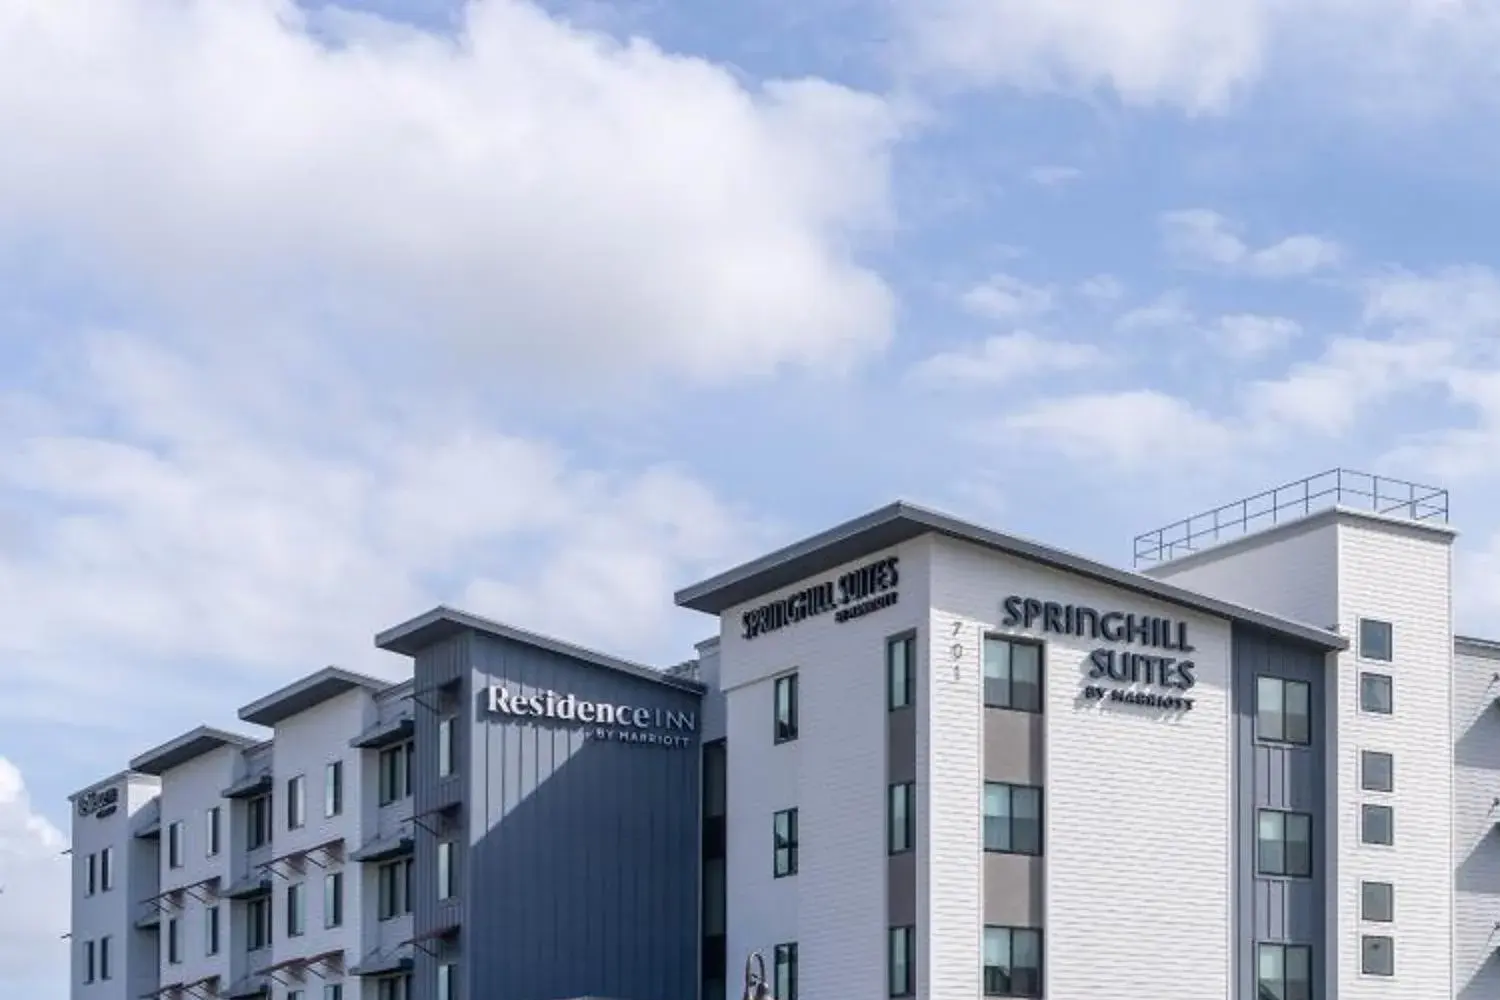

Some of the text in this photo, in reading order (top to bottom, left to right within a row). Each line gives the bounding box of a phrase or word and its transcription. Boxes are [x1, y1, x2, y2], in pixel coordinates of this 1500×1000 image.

[1002, 595, 1195, 651] SPRINGHILL
[950, 622, 963, 681] 701
[1088, 648, 1195, 690] SUITES
[488, 685, 696, 731] Residence INN
[619, 730, 690, 748] MARRIOTT
